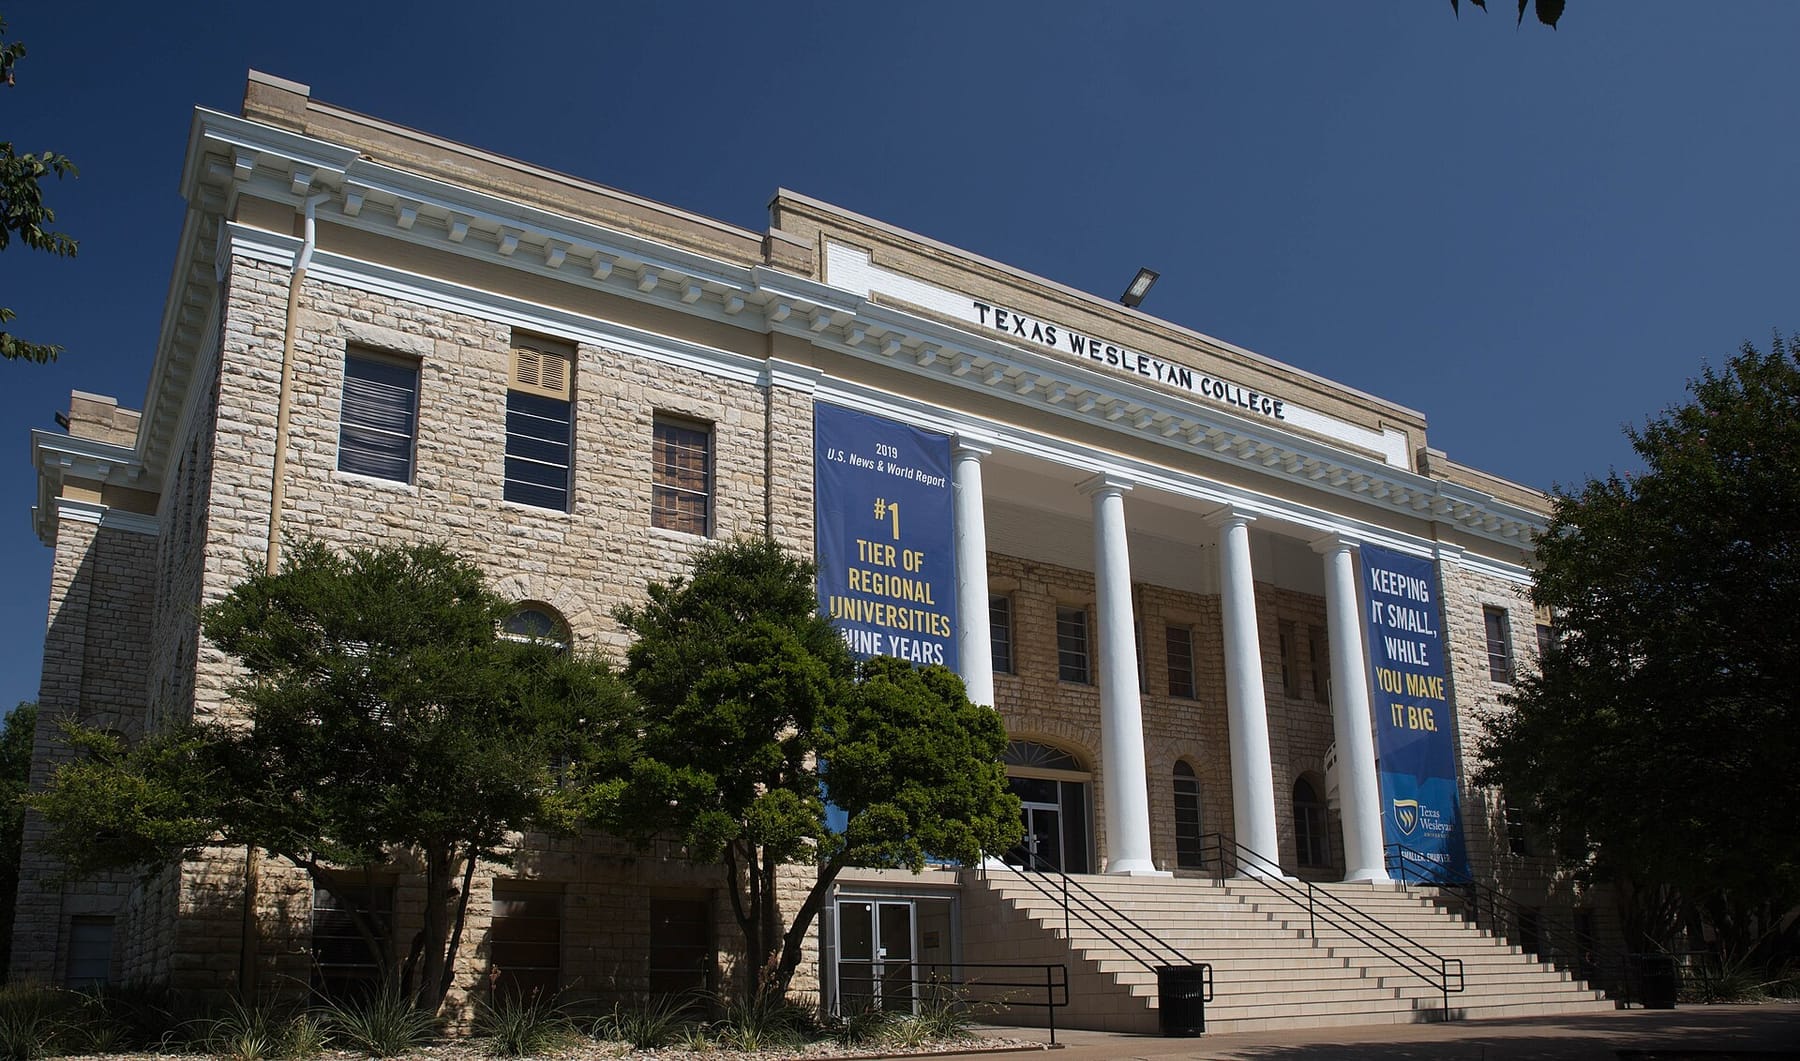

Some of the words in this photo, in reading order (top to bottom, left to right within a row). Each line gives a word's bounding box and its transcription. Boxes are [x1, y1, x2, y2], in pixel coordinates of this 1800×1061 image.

[973, 302, 1057, 345] TEXAS
[1069, 333, 1193, 390] WESLEYAN
[1202, 377, 1285, 420] COLLEGE
[827, 448, 846, 462] U.S.
[849, 453, 875, 470] News
[877, 460, 884, 472] &
[887, 463, 914, 479] World
[916, 470, 946, 488] Report
[876, 443, 898, 458] 2019
[874, 498, 900, 540] #1
[857, 539, 897, 568] TIER
[903, 549, 924, 573] OF
[849, 567, 934, 605] REGIONAL
[1371, 567, 1430, 603] KEEPING
[829, 595, 951, 638] UNIVERSITIES
[1372, 599, 1384, 625] IT
[1388, 604, 1437, 639] SMALL,
[889, 635, 944, 666] YEARS
[1384, 635, 1430, 666] WHILE
[1376, 666, 1402, 695] YOU
[1406, 673, 1446, 701] MAKE
[1391, 703, 1404, 728] IT
[1408, 706, 1438, 732] BIG.
[1419, 805, 1440, 817] Texas
[1420, 818, 1454, 833] Wesleyan
